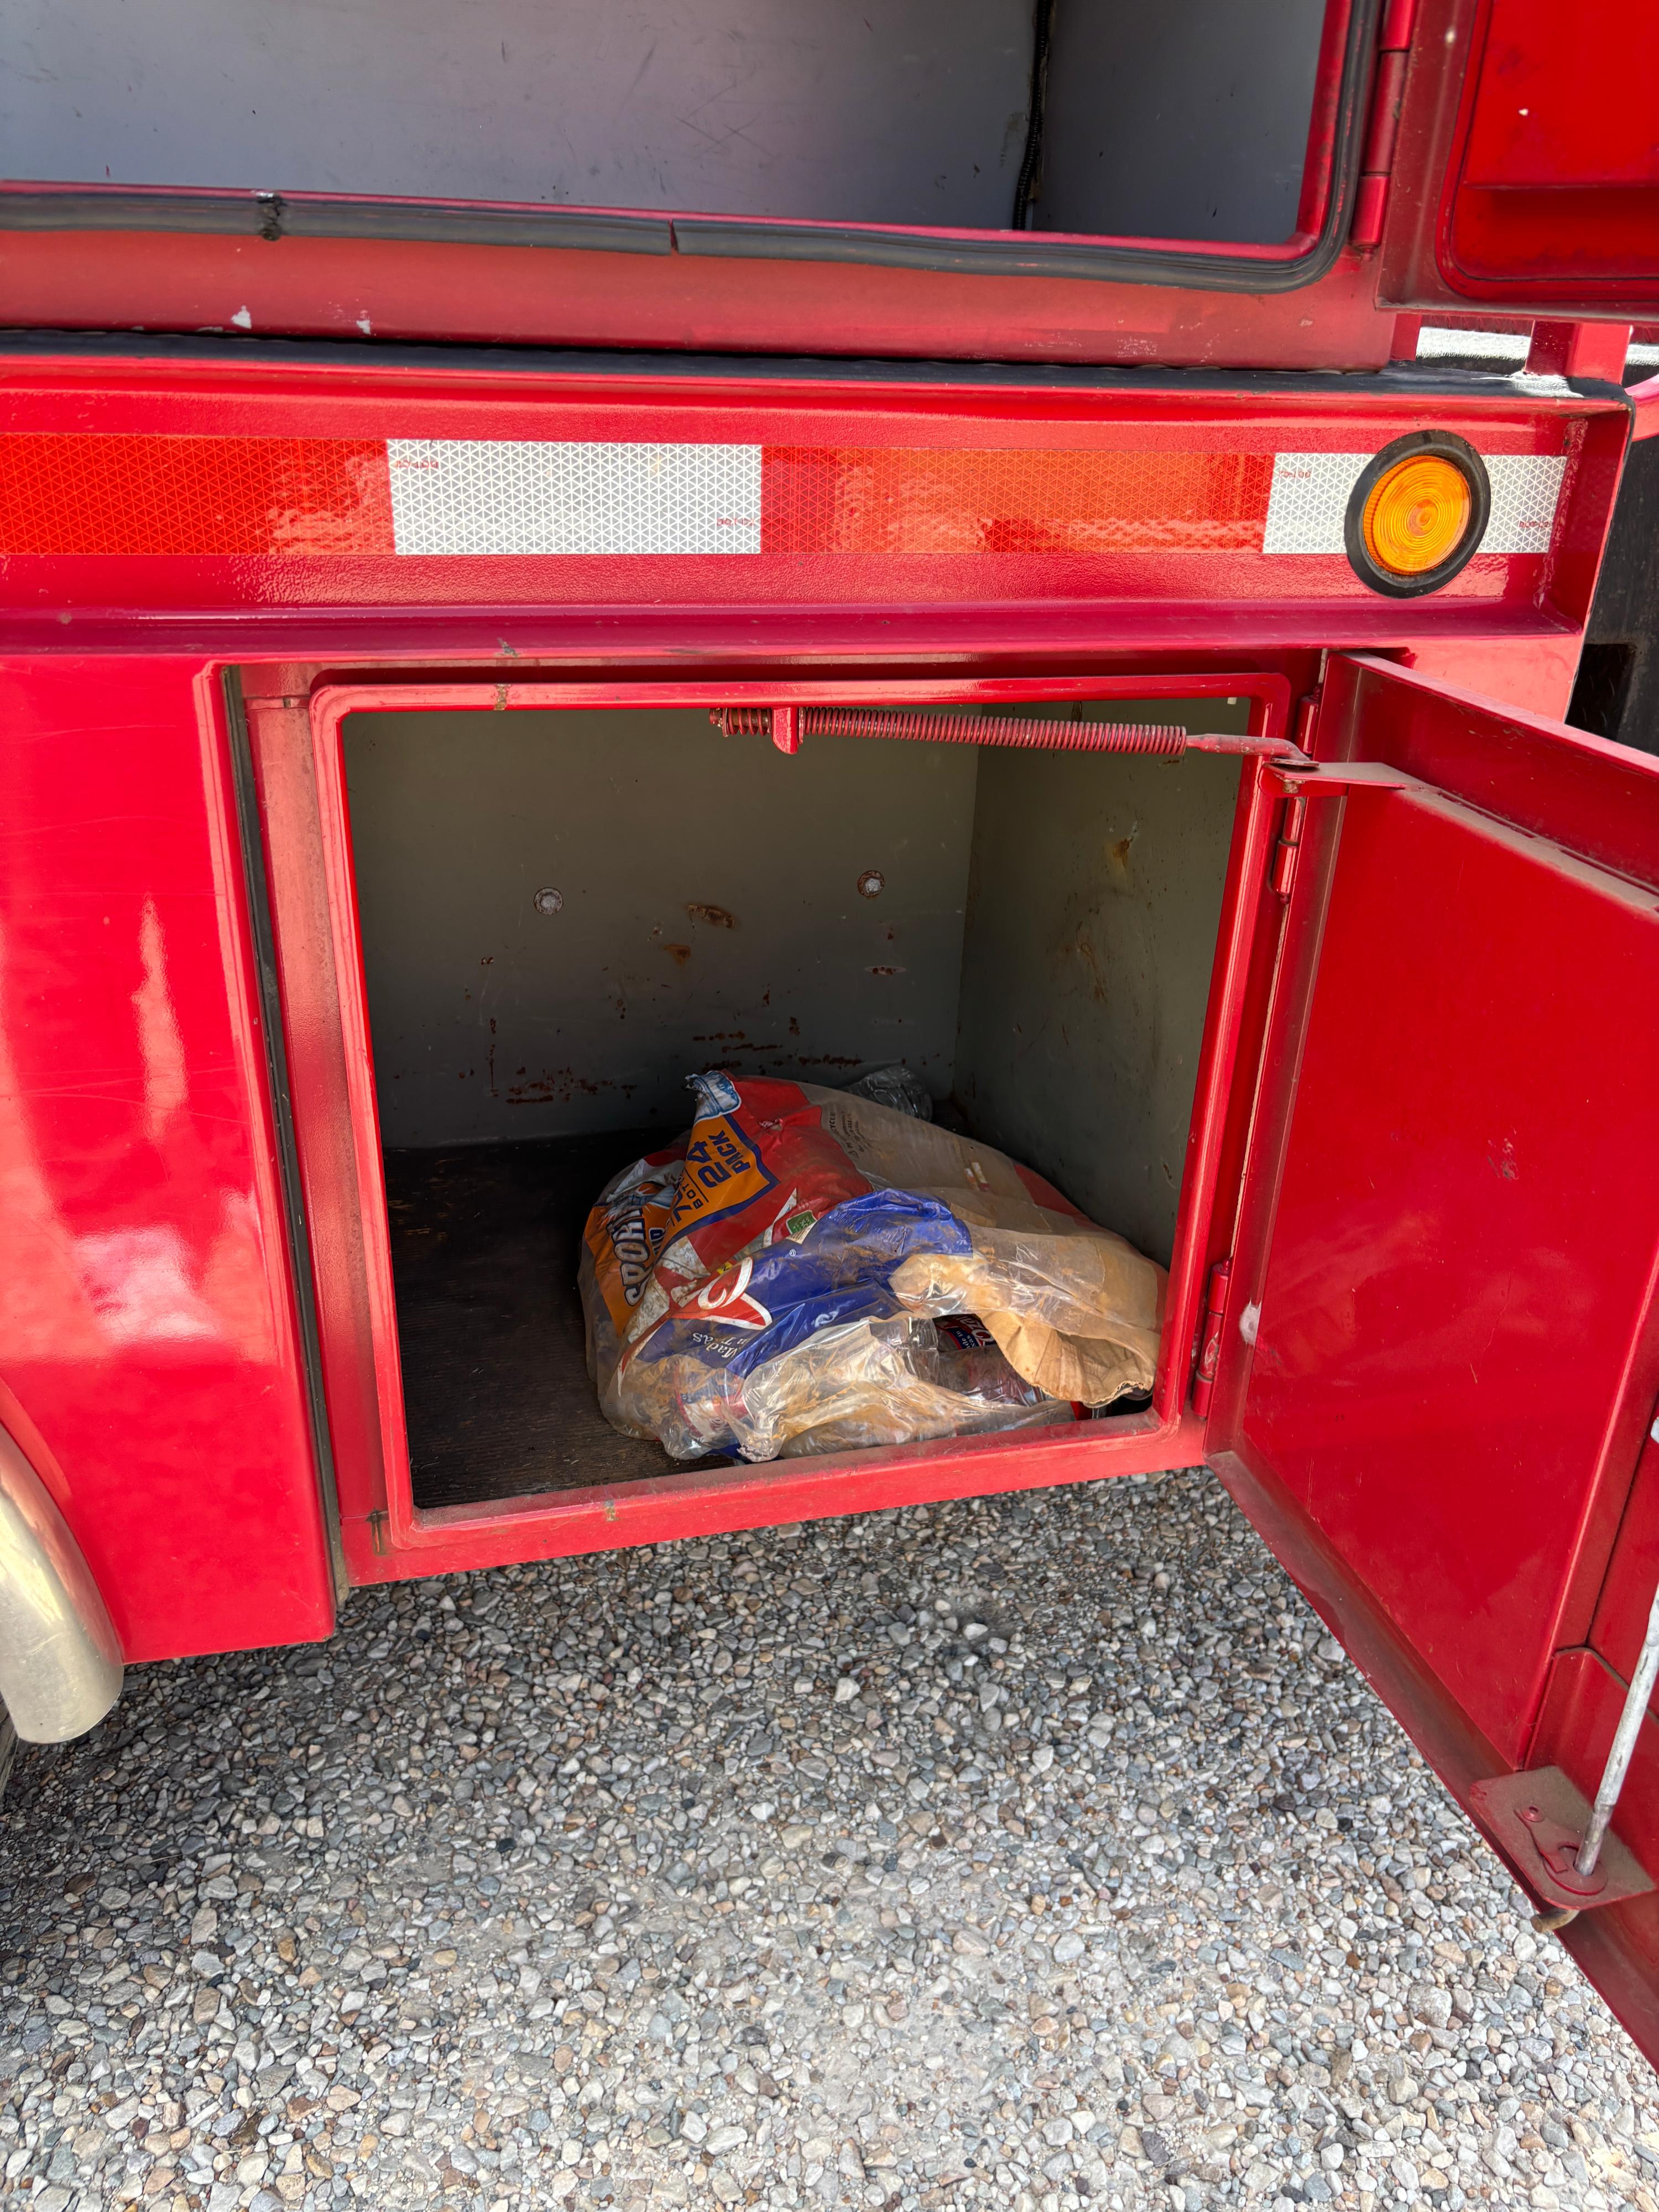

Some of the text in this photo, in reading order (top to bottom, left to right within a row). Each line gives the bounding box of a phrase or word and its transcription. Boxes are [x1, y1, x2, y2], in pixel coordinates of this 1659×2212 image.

[686, 1141, 732, 1188] 24
[708, 1130, 751, 1174] PACK
[606, 1208, 653, 1307] SPORT
[706, 1342, 738, 1358] Mad
